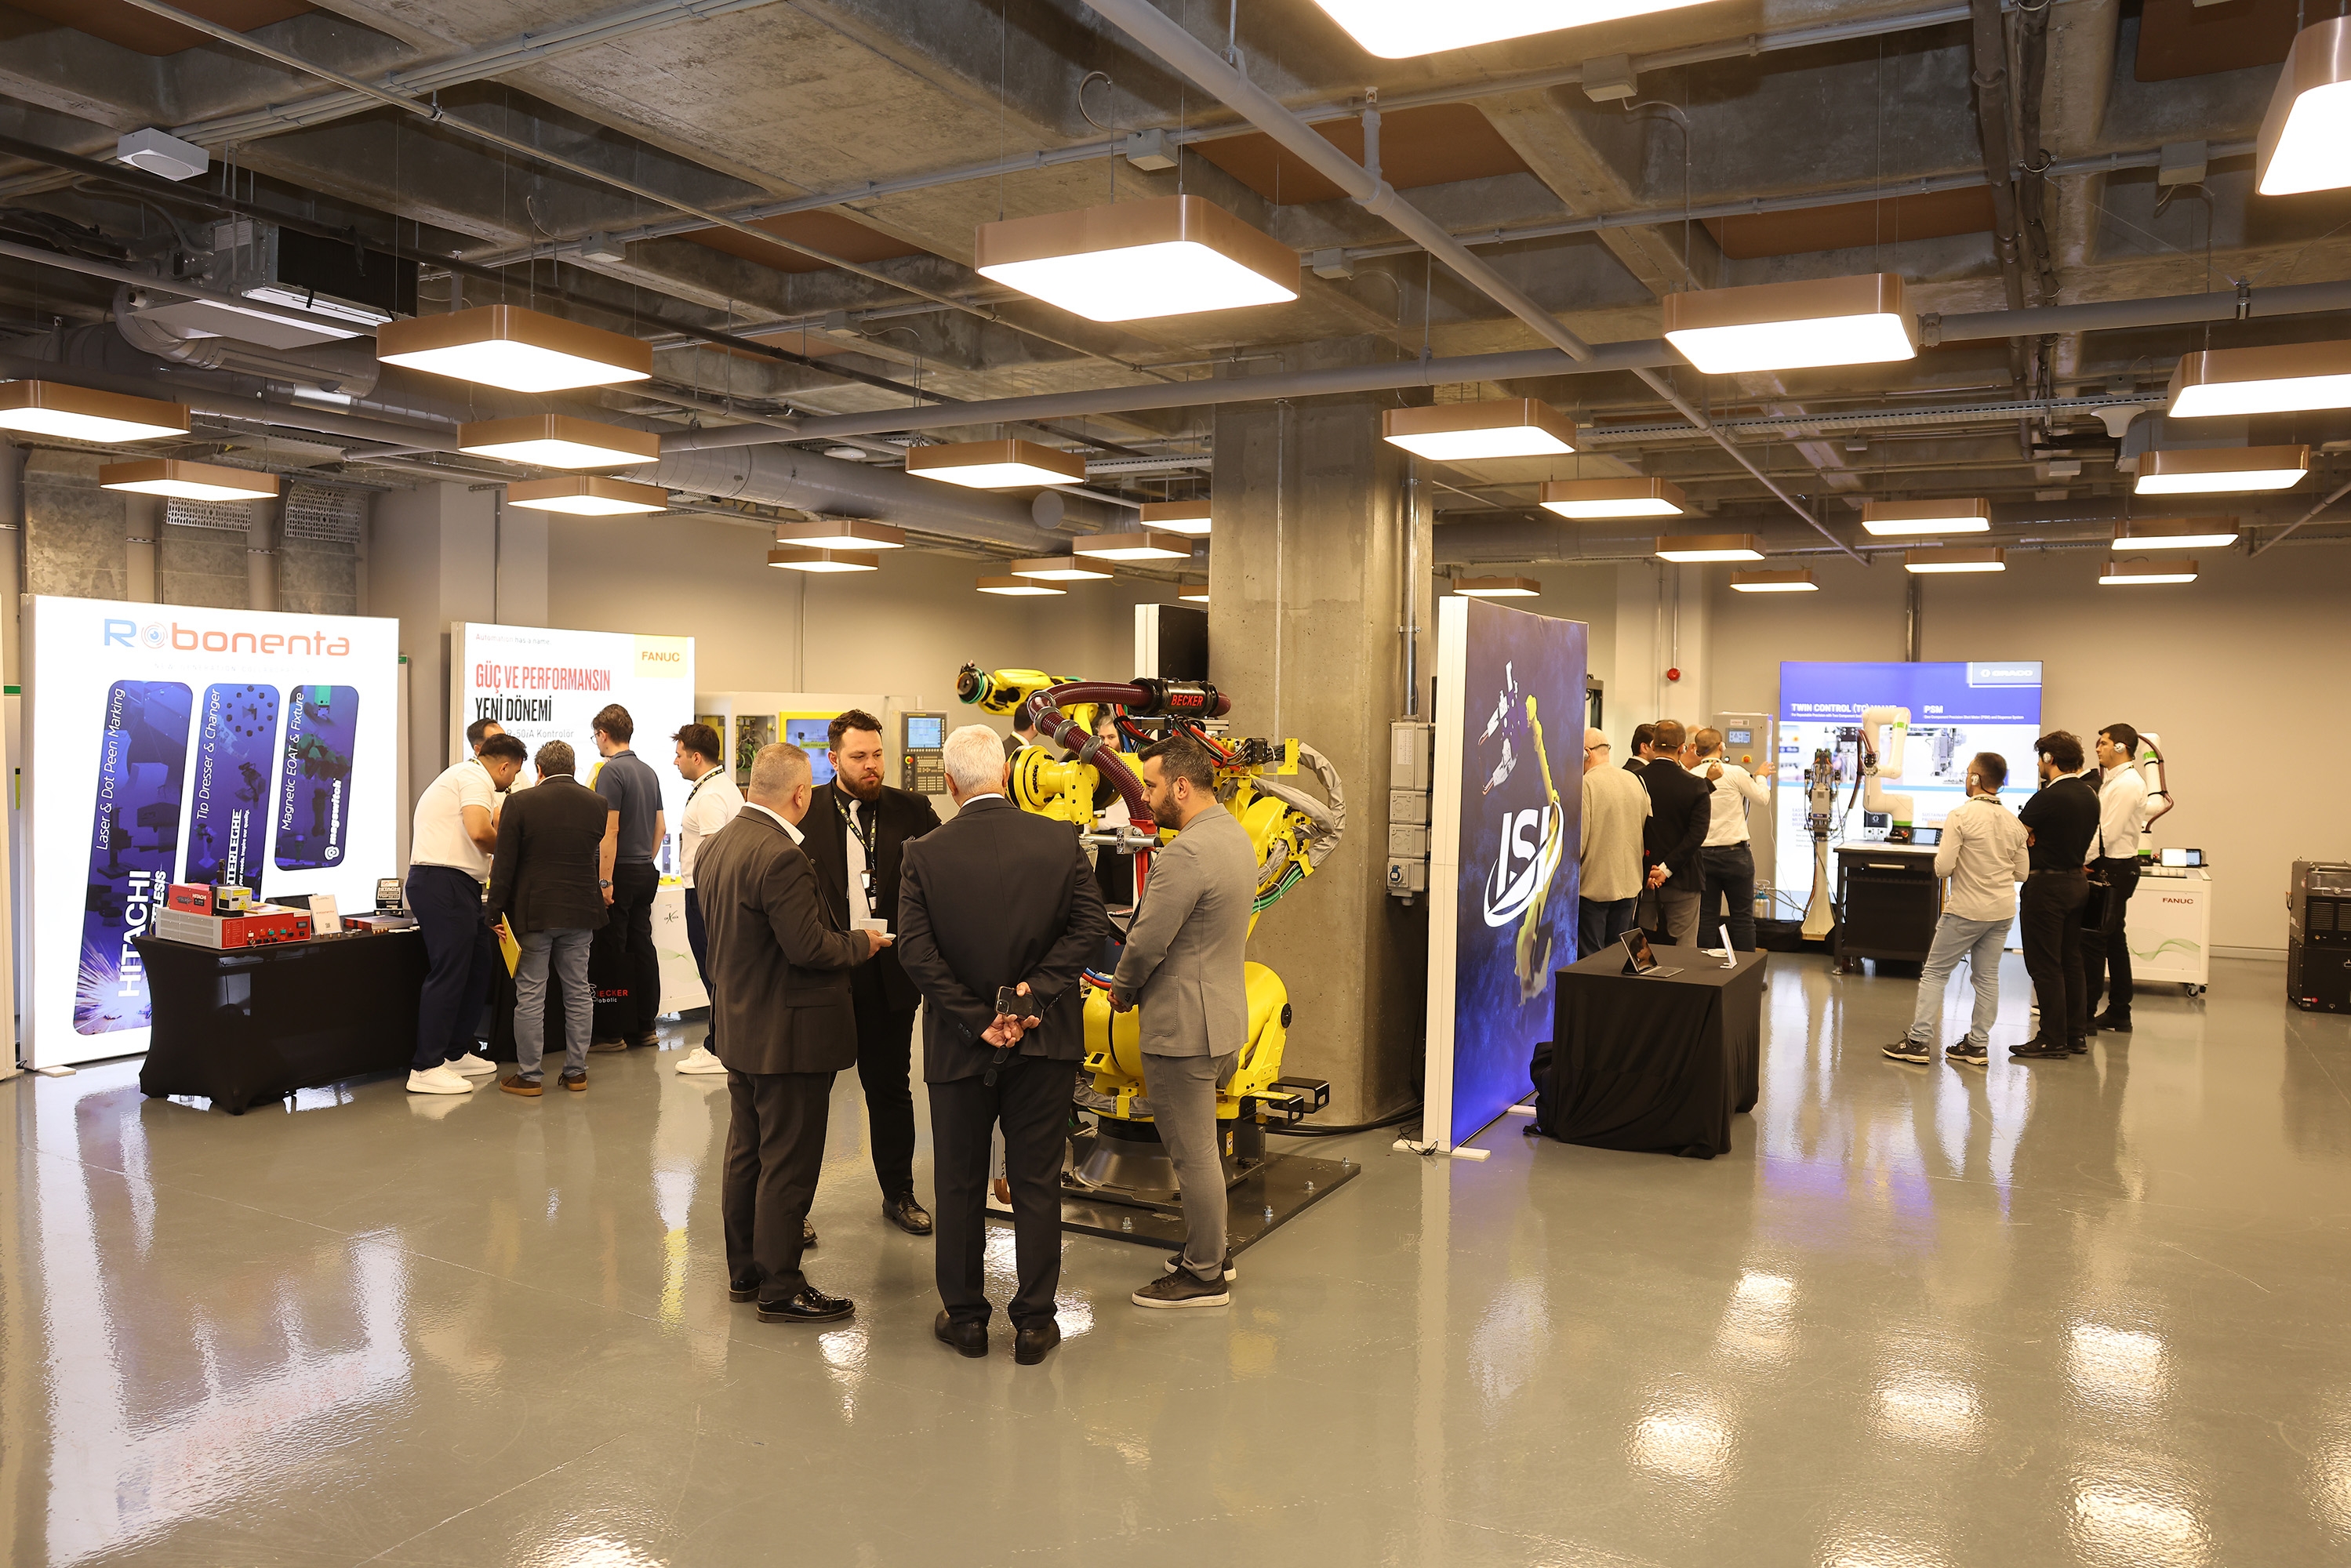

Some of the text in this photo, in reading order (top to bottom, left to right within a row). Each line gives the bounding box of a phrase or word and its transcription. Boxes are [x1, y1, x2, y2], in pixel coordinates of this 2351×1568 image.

[104, 618, 350, 656] Robonenta
[475, 632, 514, 643] Automation
[641, 651, 680, 662] FANUC
[475, 660, 610, 694] GÜÇ VE PERFORMANSIN
[475, 694, 552, 722] YENİ DÖNEMİ
[1171, 695, 1204, 706] BECKER
[1791, 703, 1812, 712] TWIN
[1814, 704, 1851, 713] CONTROL
[536, 728, 574, 739] Kontrolör
[96, 688, 126, 850] Laser & Dot Peen Marking
[197, 688, 221, 819] Tip Dresser & Changer
[281, 692, 305, 830] Magnetic EOAT & Fixture
[329, 778, 343, 845] magswitch
[118, 871, 151, 997] HITACHI
